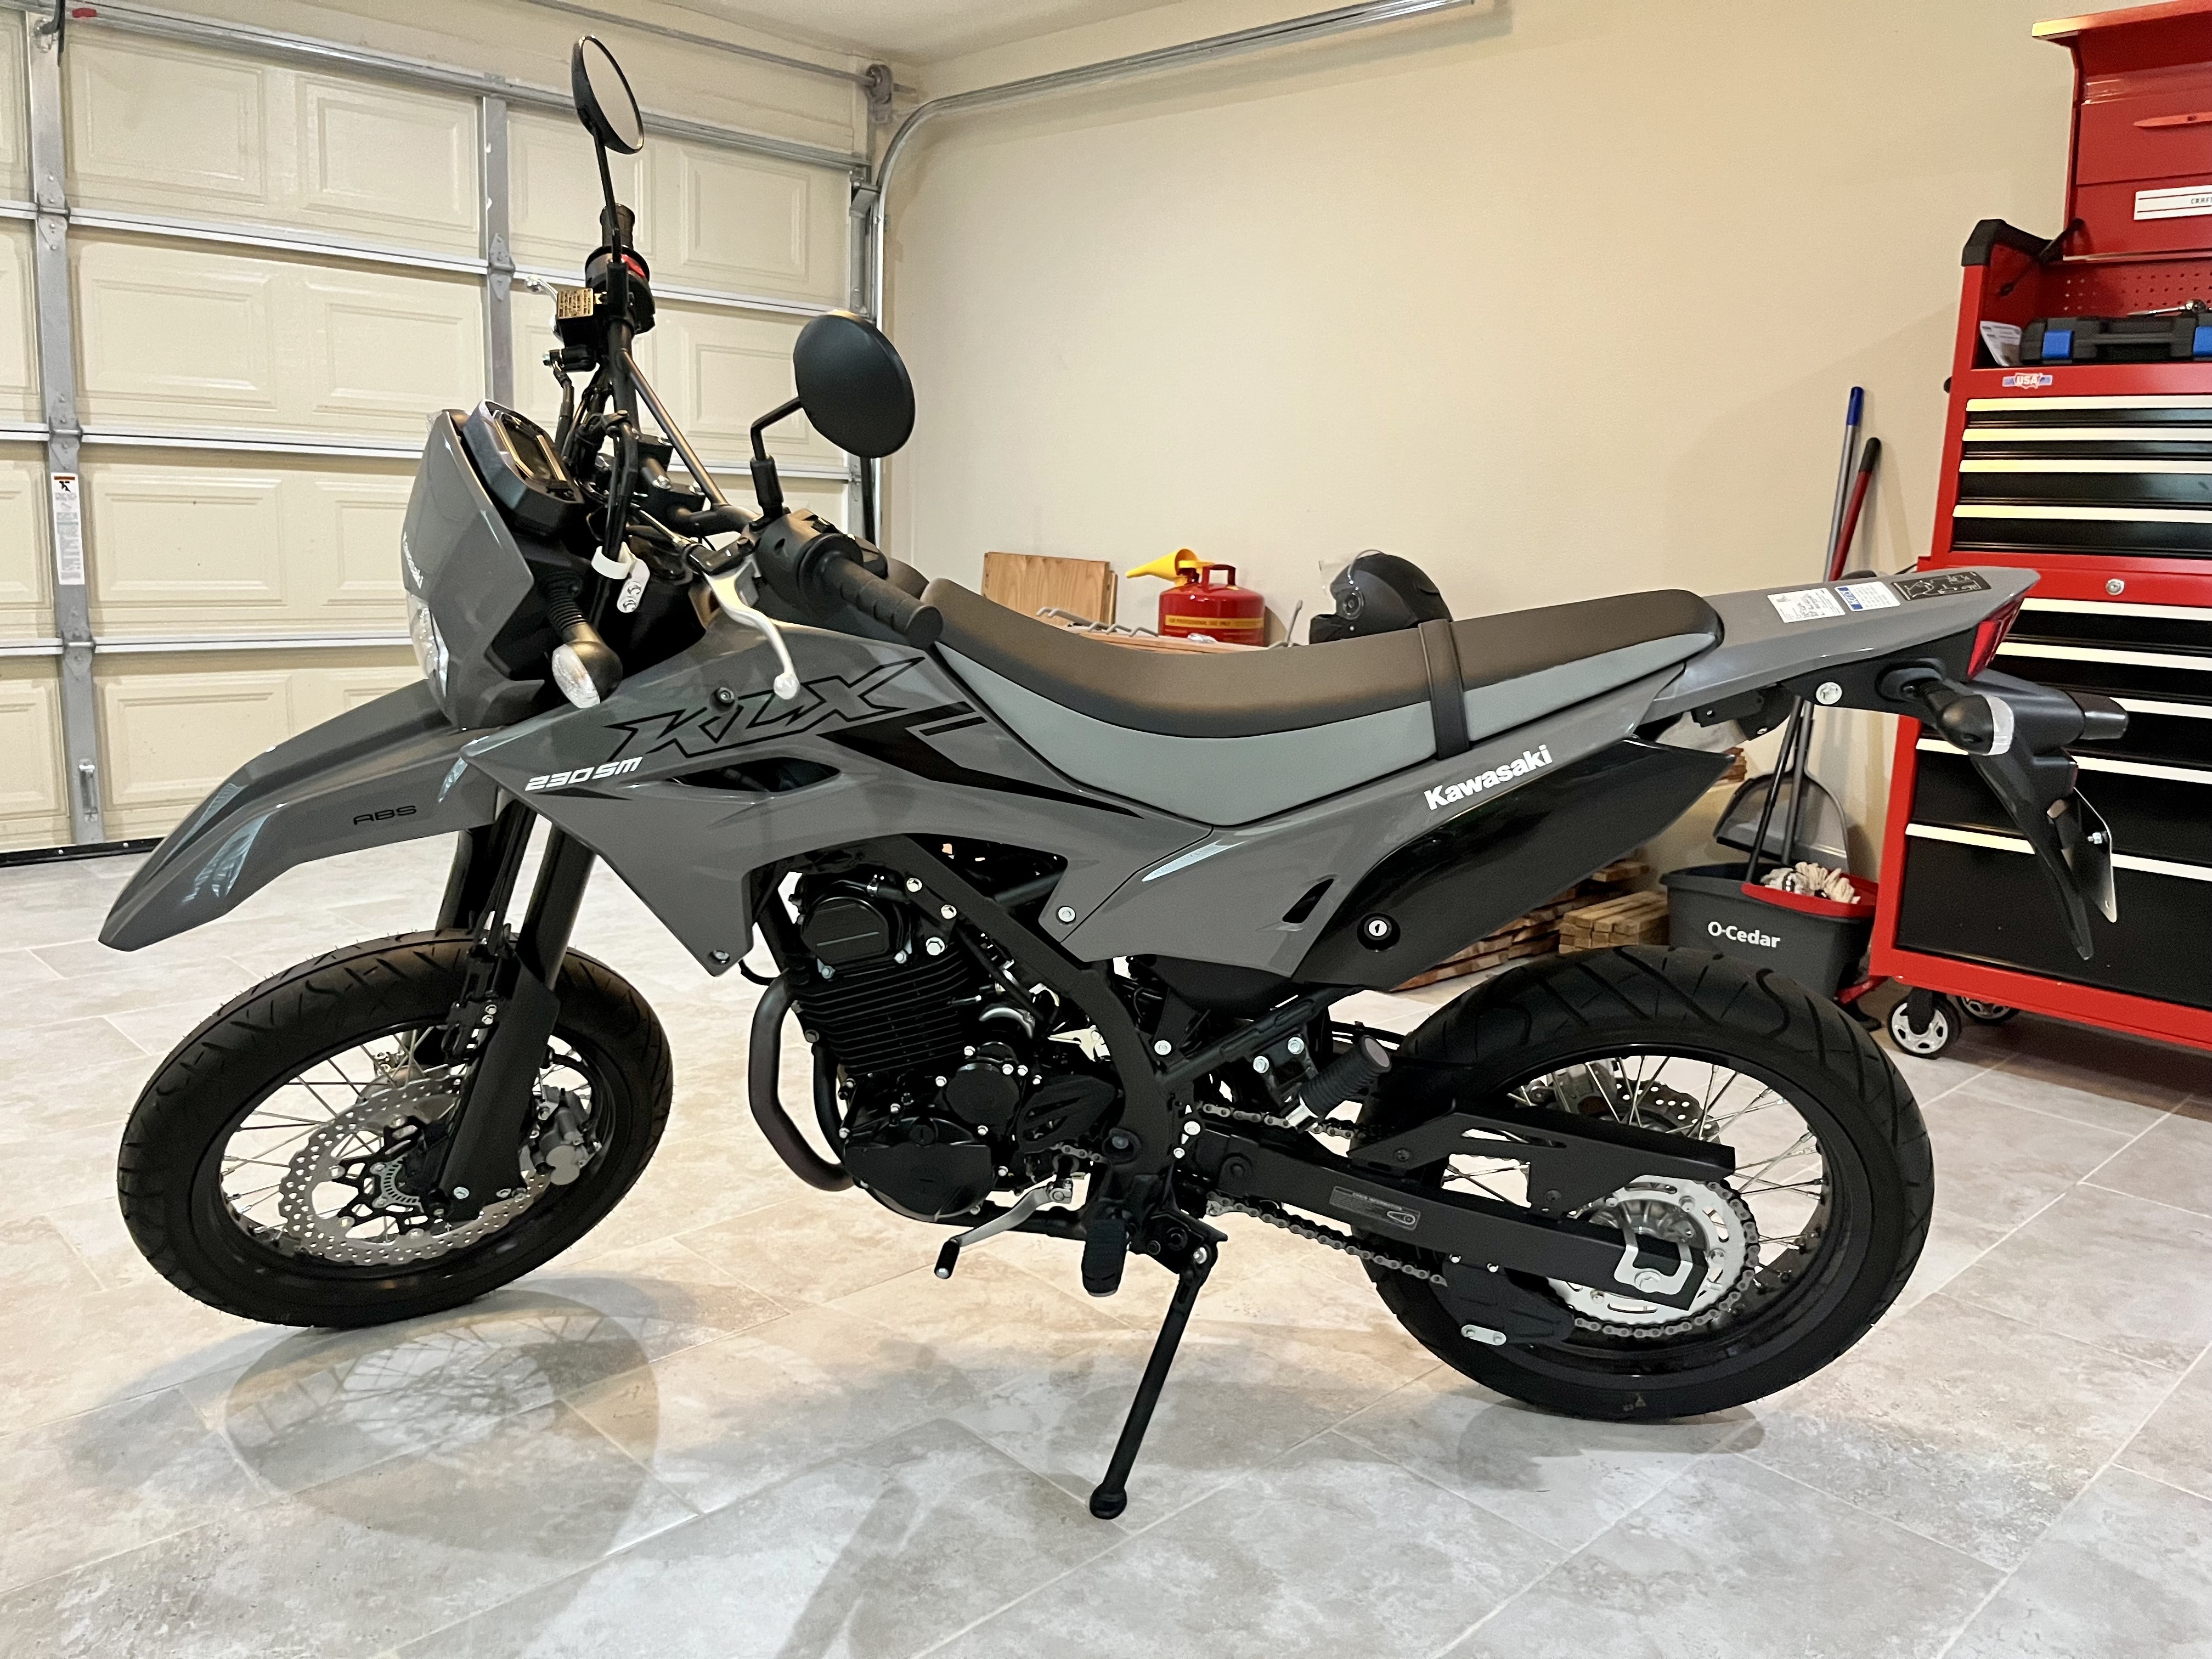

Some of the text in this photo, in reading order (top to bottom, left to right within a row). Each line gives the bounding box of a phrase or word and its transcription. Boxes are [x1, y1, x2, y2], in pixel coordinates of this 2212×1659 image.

[2016, 375, 2038, 385] USA
[604, 657, 926, 761] KLX
[1424, 744, 1553, 810] Kawasaki
[353, 805, 417, 825] ABS
[1708, 921, 1781, 948] O-Cedar
